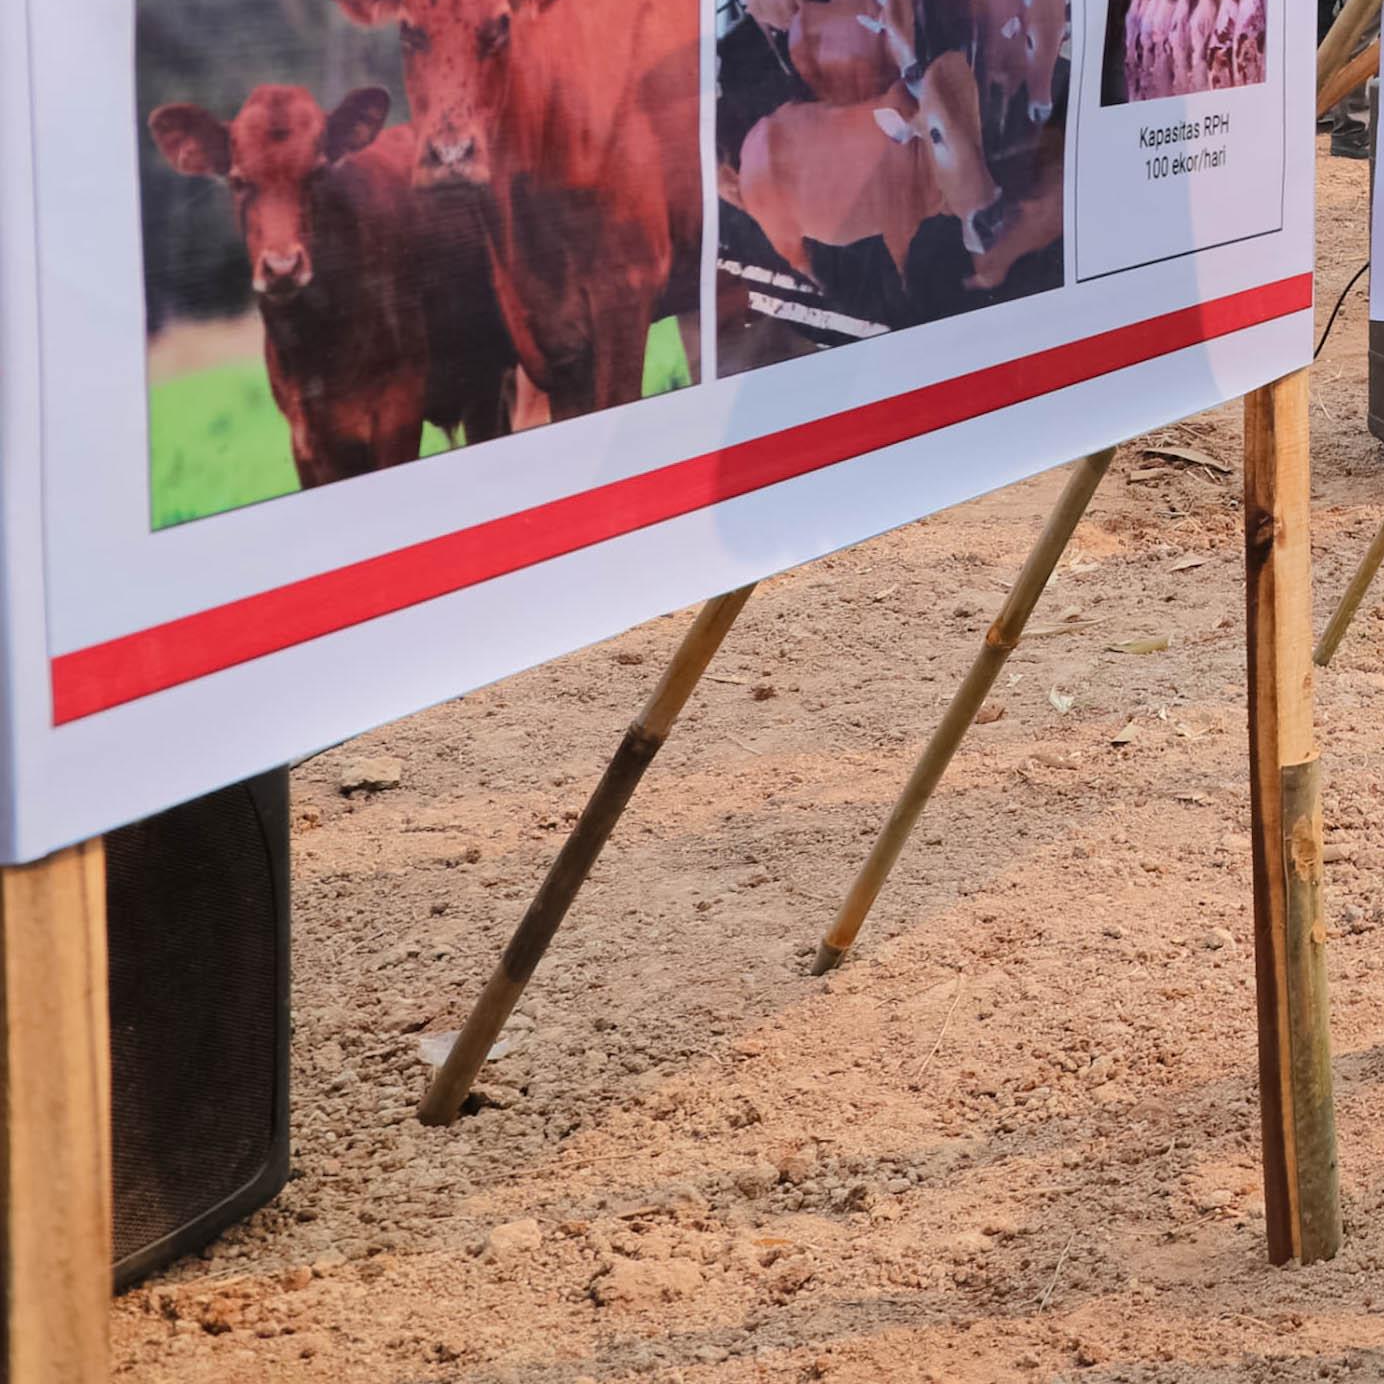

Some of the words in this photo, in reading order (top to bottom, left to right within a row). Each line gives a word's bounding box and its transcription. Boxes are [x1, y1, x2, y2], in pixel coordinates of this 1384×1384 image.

[1139, 120, 1201, 149] Kapasitas
[1203, 113, 1230, 138] RPH
[1145, 158, 1169, 181] 100
[1170, 149, 1227, 177] ekor/hari
